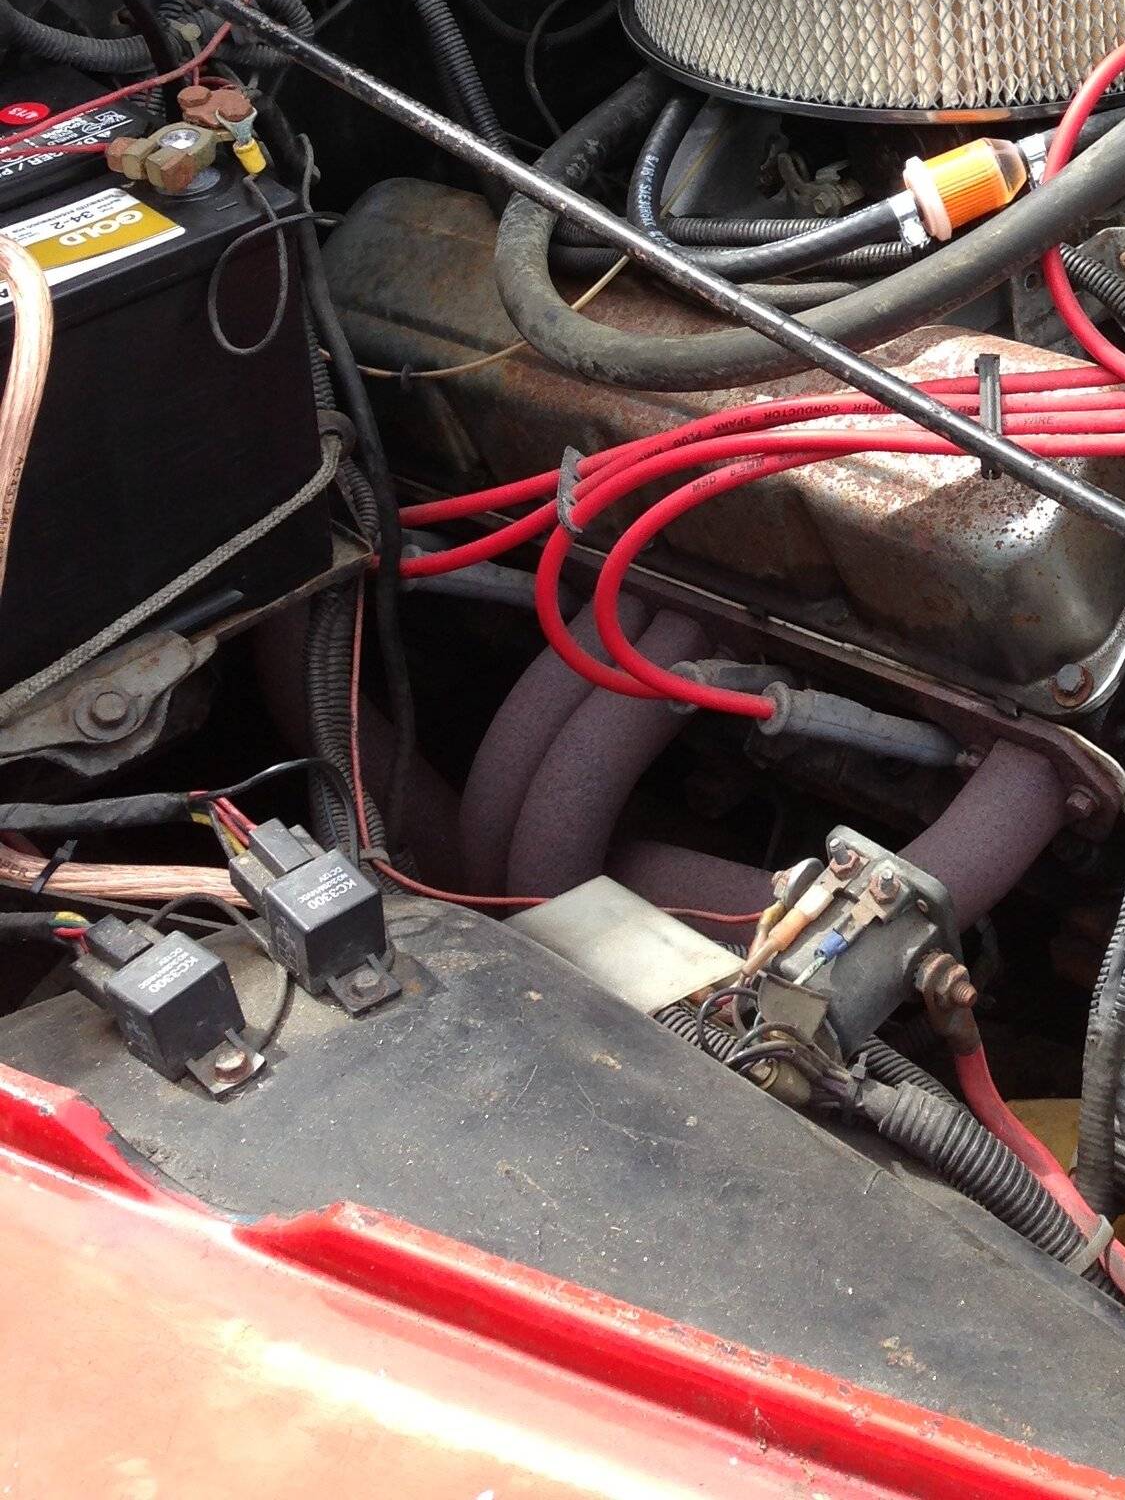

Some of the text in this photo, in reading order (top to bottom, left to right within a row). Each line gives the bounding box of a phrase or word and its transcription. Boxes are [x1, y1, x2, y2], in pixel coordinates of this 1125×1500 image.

[50, 210, 94, 229] 34-2
[59, 209, 144, 246] GOLD
[762, 403, 840, 421] CONDUCTOR
[1022, 415, 1055, 427] WIRE
[711, 415, 751, 431] SPARK
[672, 431, 703, 449] PLUG
[692, 474, 718, 493] MSD
[306, 878, 357, 910] KC3300
[148, 956, 199, 993] KC3300
